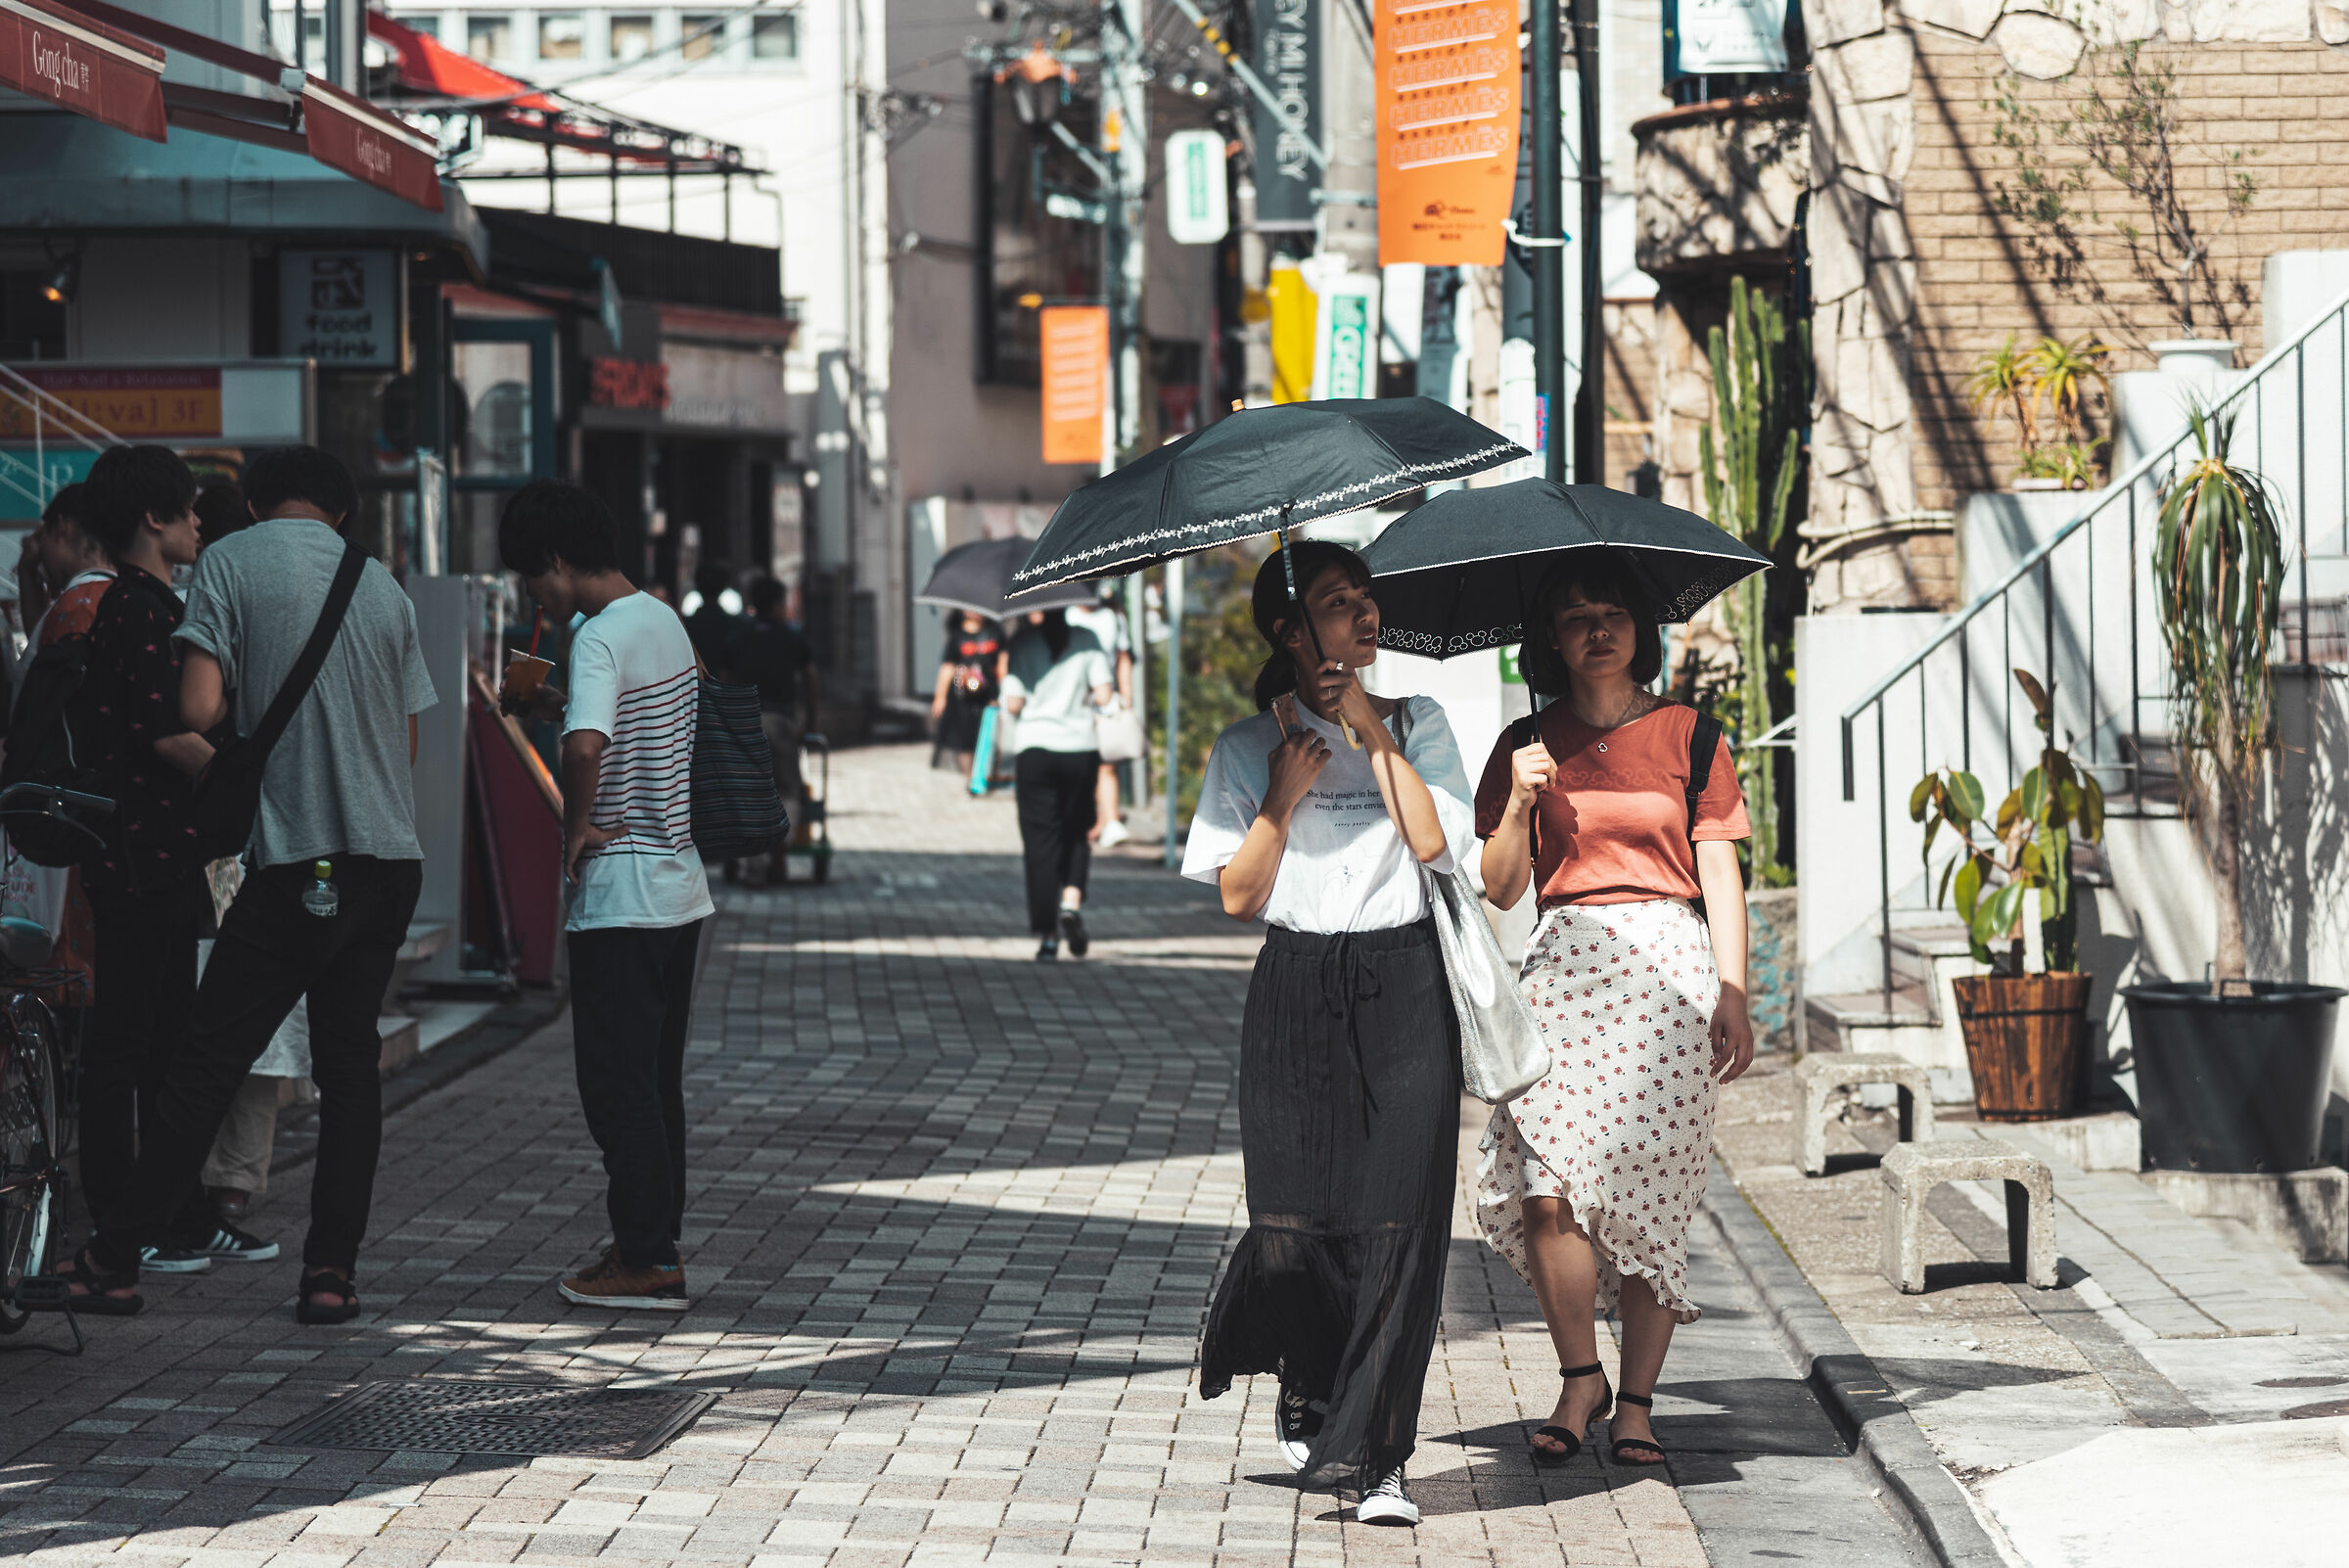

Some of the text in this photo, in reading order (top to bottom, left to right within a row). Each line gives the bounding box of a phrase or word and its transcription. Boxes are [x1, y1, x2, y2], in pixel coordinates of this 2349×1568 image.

[33, 30, 61, 98] Gong
[62, 41, 79, 90] cha
[304, 312, 372, 334] food
[299, 337, 378, 358] drink
[172, 397, 204, 424] 3F
[1307, 790, 1319, 799] She
[1320, 791, 1333, 801] had
[1335, 791, 1357, 800] magic
[1367, 789, 1380, 798] her
[1332, 803, 1344, 811] the
